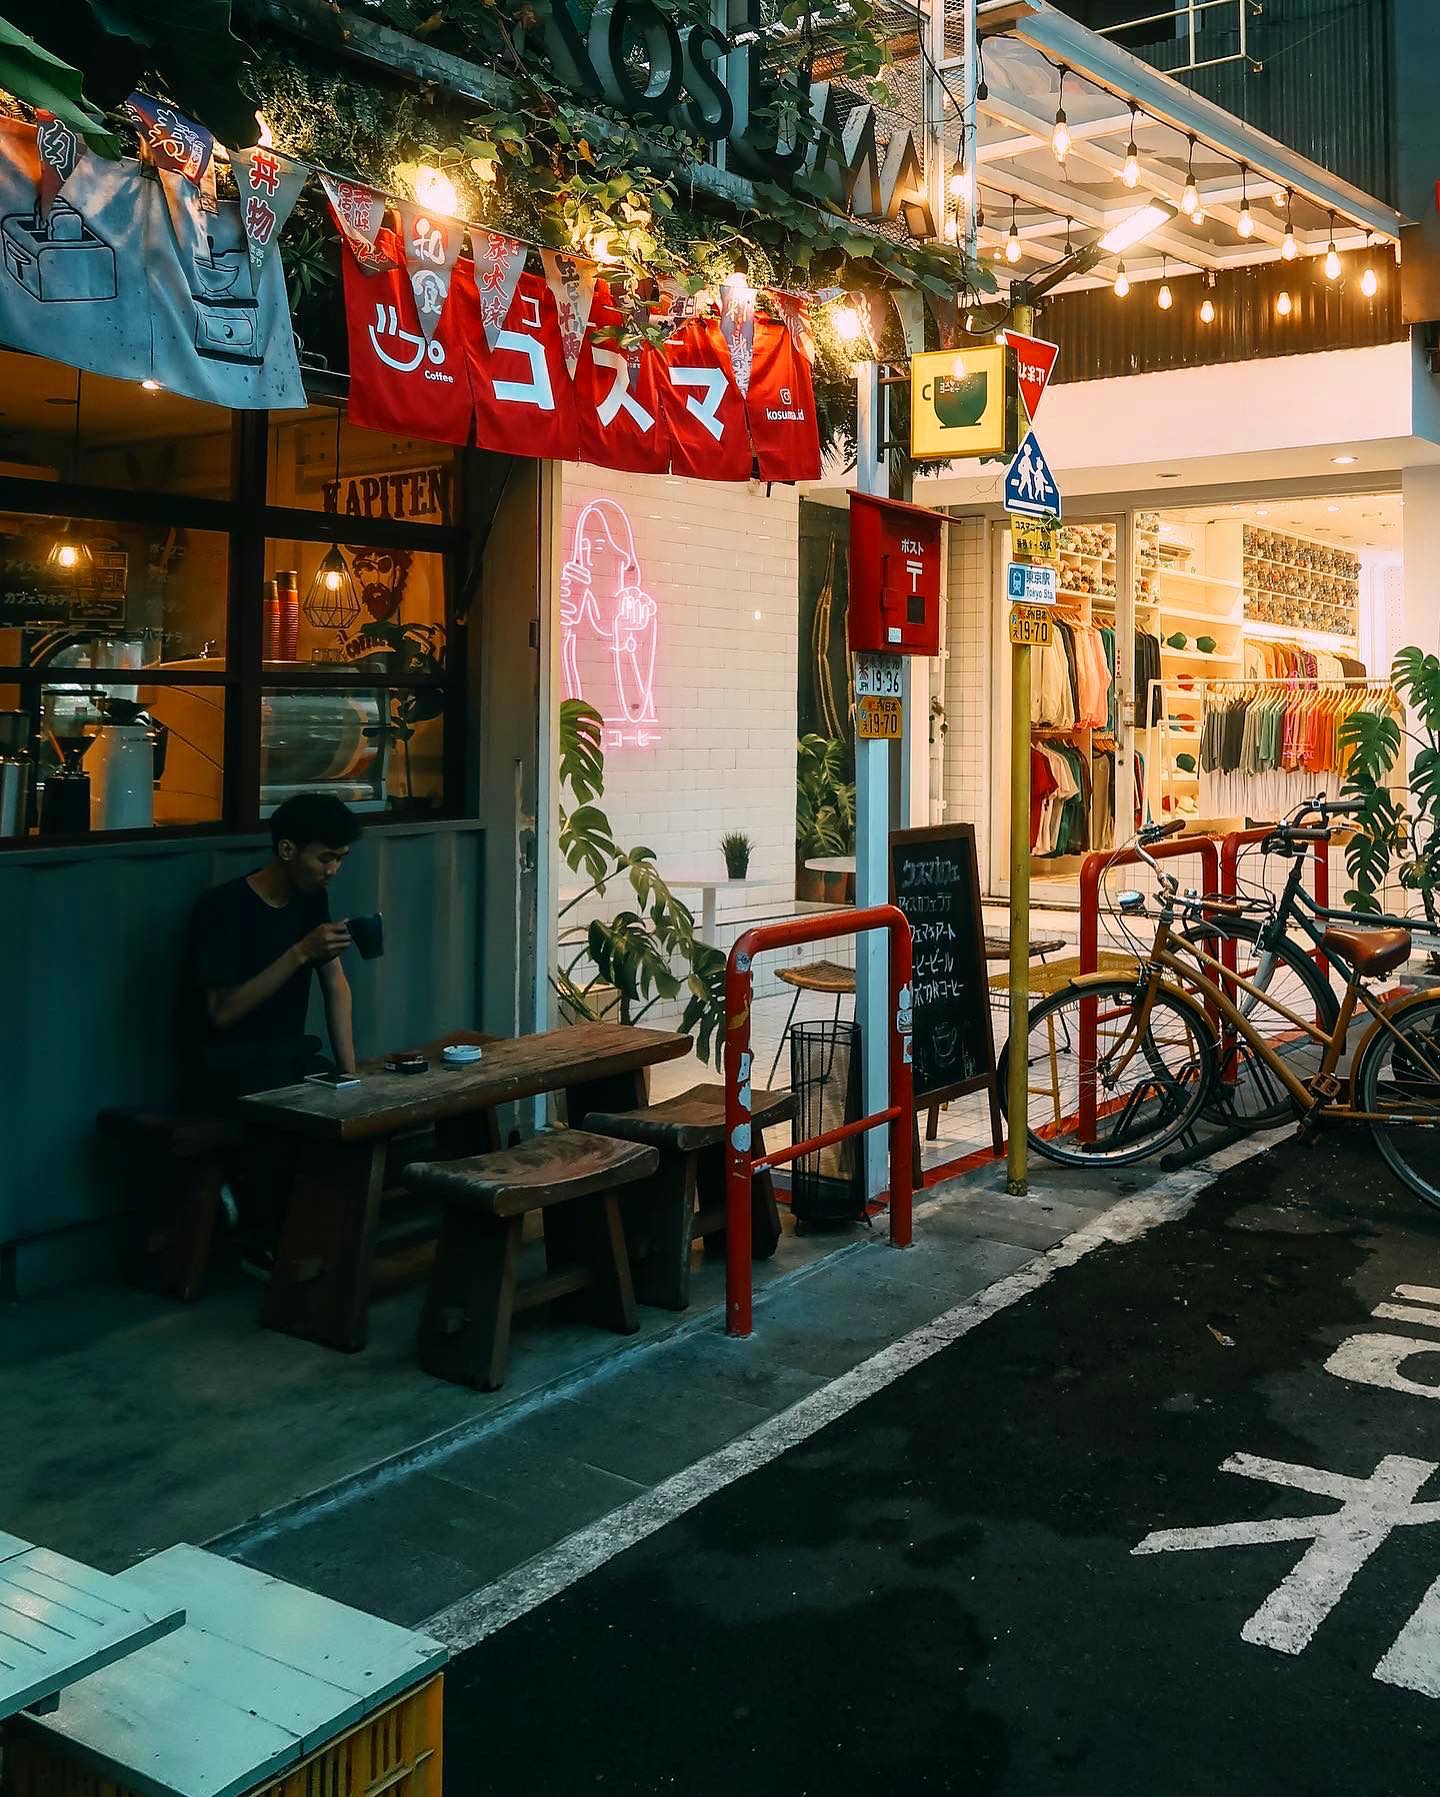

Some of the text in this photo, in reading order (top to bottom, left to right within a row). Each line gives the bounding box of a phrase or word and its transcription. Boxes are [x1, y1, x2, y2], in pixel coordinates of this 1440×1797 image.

[246, 149, 280, 246] 丼物
[480, 232, 508, 330] 炭火焼
[424, 369, 454, 384] Coffee
[490, 328, 729, 443] コスマ
[766, 407, 805, 421] kosuma.id
[1026, 570, 1051, 586] 東京駅
[1026, 586, 1043, 600] Tokyo
[607, 729, 662, 747] コーヒー
